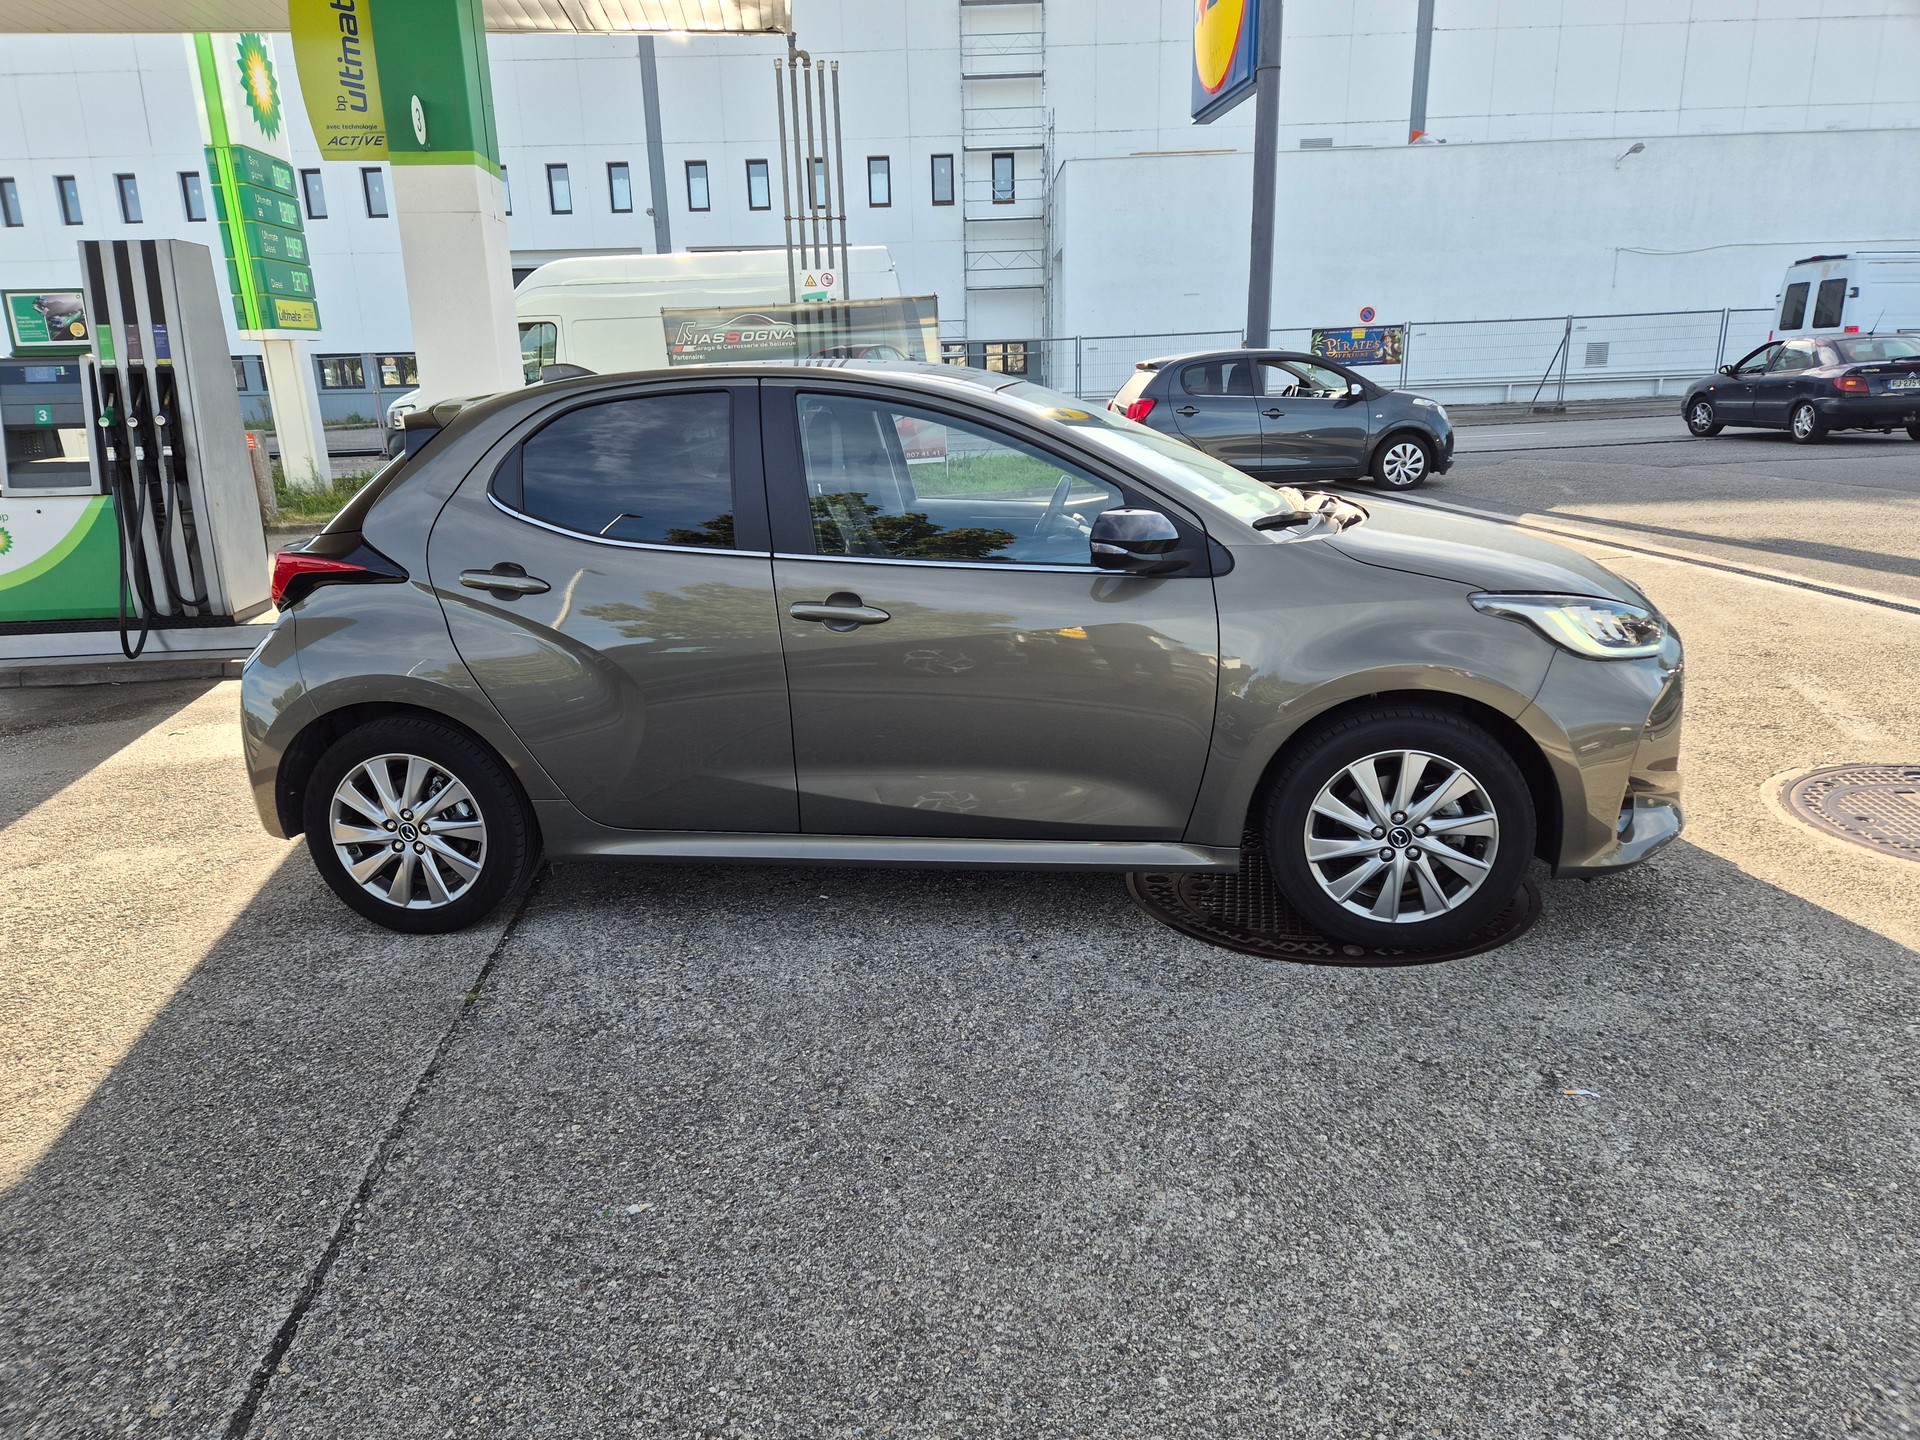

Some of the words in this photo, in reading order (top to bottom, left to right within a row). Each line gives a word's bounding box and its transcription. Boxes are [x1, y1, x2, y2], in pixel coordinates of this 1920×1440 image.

[336, 95, 347, 111] bp
[415, 107, 422, 132] 3
[341, 123, 378, 131] technologie
[327, 135, 385, 146] ACTIVE
[278, 308, 303, 323] ultimate
[723, 341, 756, 350] Carrosserie
[769, 339, 797, 347] Bellevue
[38, 409, 48, 422] 3
